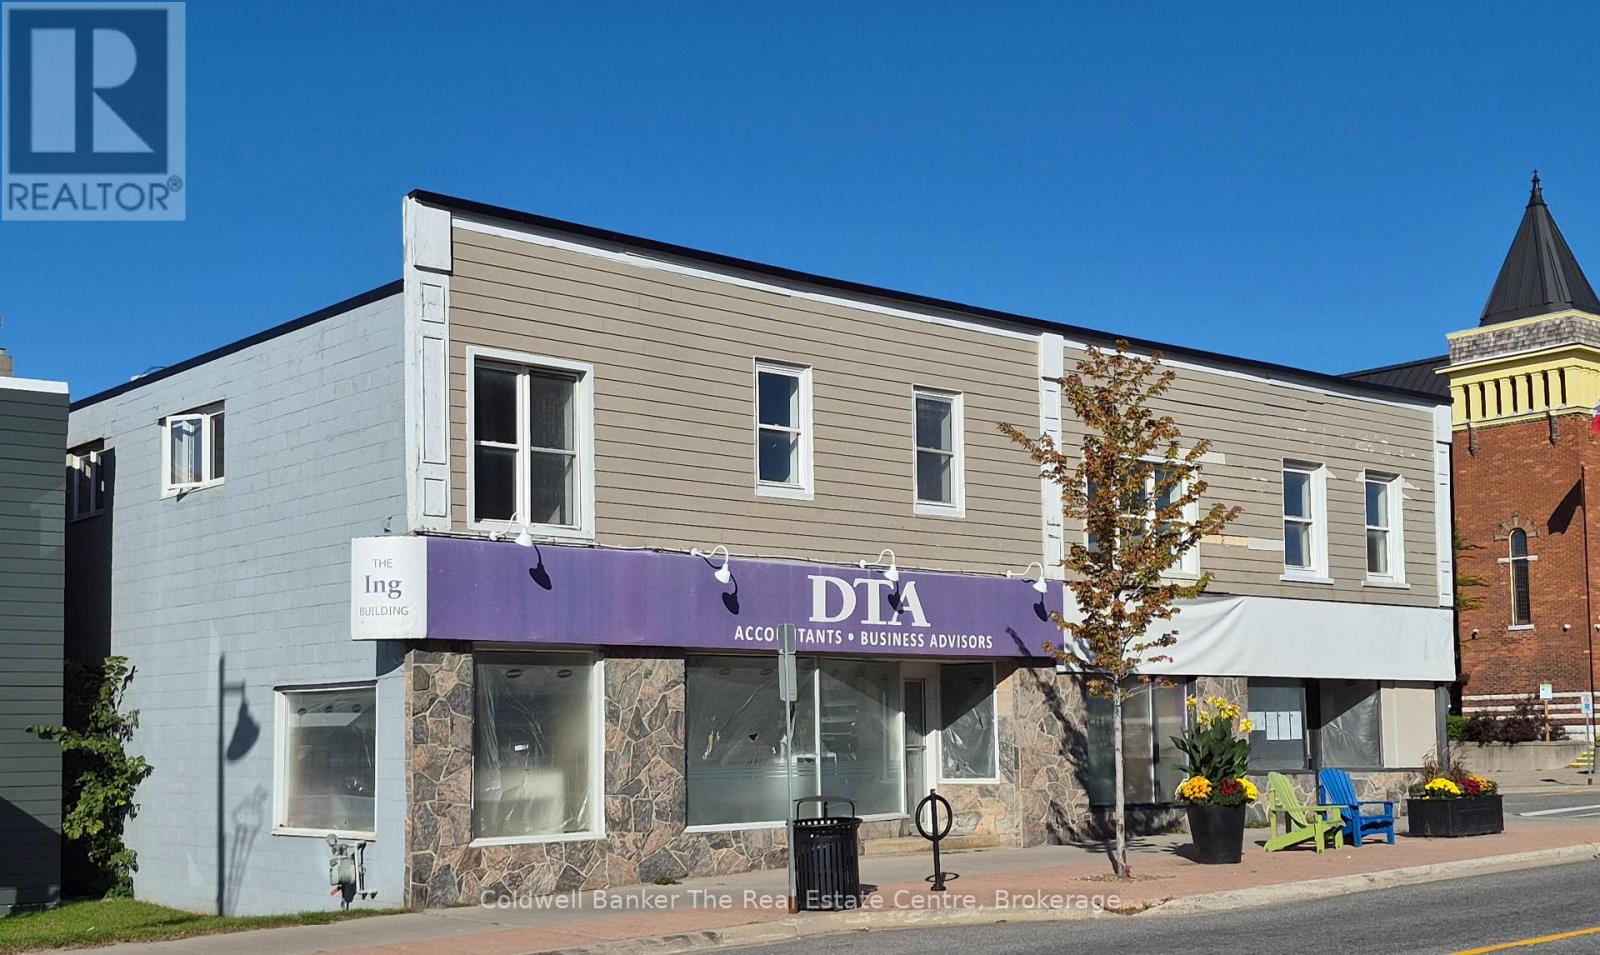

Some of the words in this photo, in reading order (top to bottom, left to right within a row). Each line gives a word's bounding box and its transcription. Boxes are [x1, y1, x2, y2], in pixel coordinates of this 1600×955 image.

[372, 558, 393, 569] THE
[365, 575, 402, 600] Ing
[359, 605, 409, 617] BUILDING
[808, 575, 931, 627] DTA
[734, 625, 843, 645] ACCOTANTS
[860, 631, 925, 648] BUSINESS
[929, 634, 993, 649] ADVISORS
